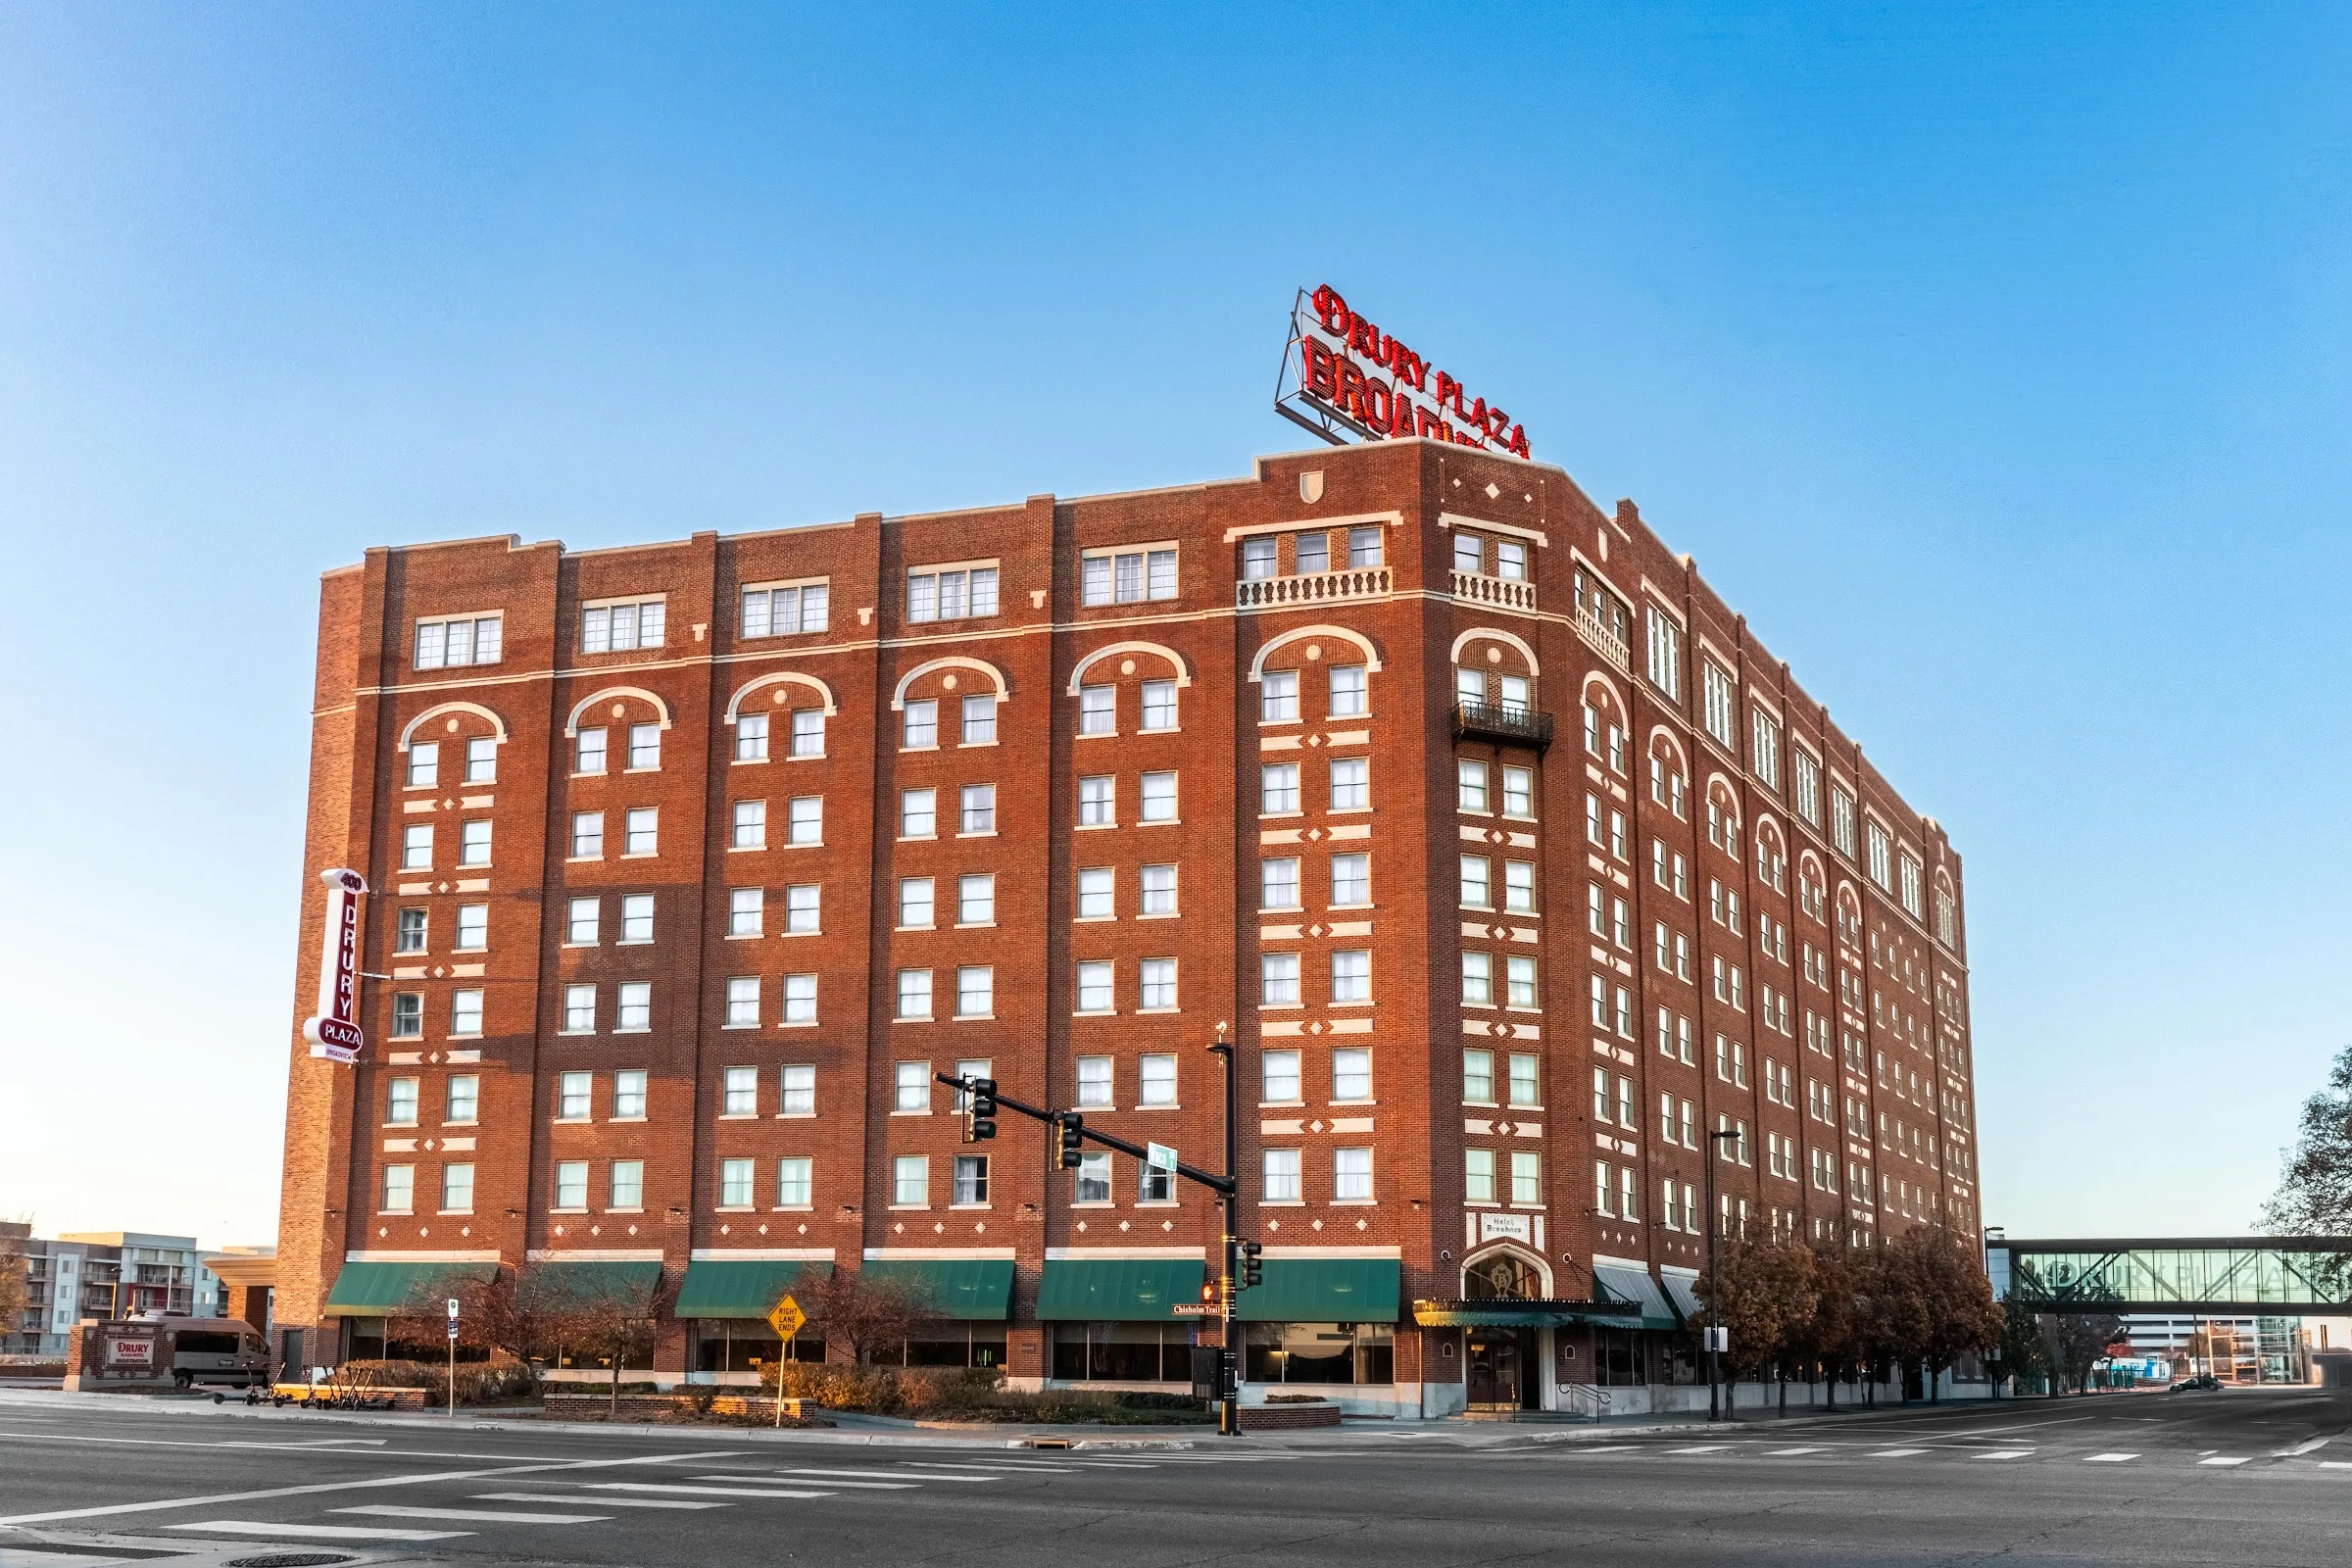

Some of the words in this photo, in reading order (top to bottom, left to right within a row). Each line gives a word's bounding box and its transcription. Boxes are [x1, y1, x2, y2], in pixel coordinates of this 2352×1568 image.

[1312, 283, 1432, 393] DRURY
[1437, 370, 1530, 460] PLAZA
[1304, 334, 1491, 451] BROAD
[340, 906, 357, 1017] DRURY
[325, 1024, 361, 1046] PLAZA
[326, 1049, 352, 1059] BROADVIEW
[2045, 1260, 2166, 1288] DRURY
[2176, 1265, 2284, 1288] PLAZA
[1173, 1305, 1204, 1314] Chisholm
[117, 1342, 149, 1352] DRURY
